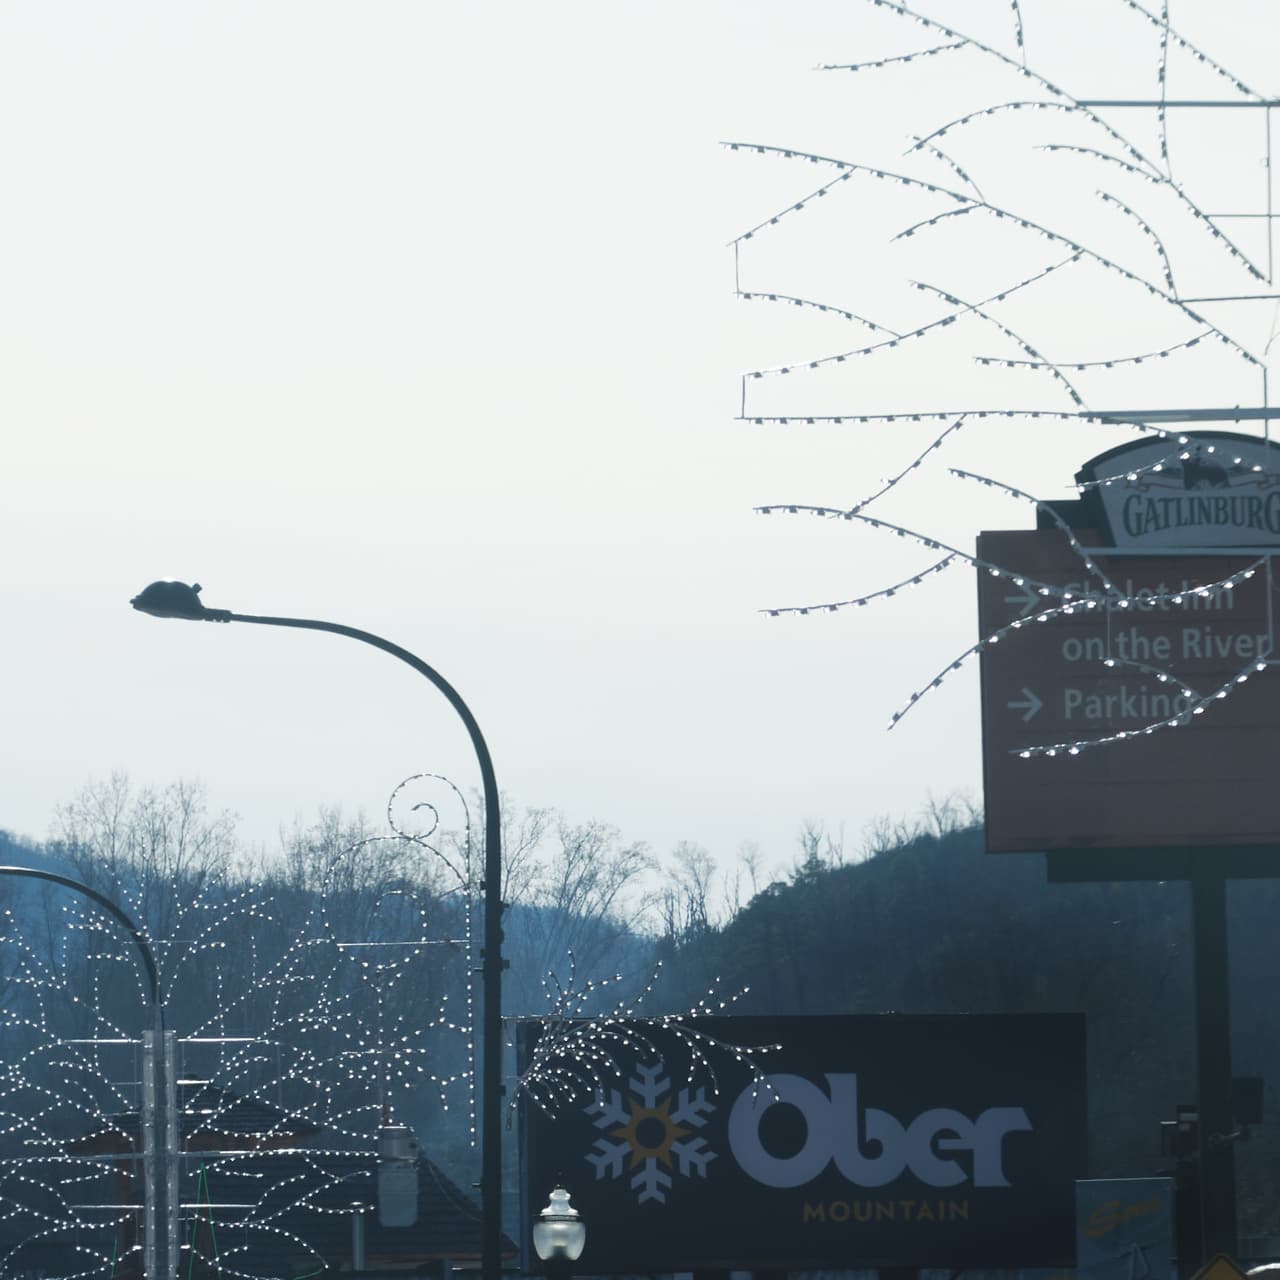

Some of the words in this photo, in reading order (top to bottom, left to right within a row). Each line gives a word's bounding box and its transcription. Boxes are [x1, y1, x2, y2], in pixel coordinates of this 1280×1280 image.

[1062, 637, 1104, 661] on
[1114, 627, 1170, 660] the
[1182, 626, 1268, 659] River
[1064, 685, 1193, 725] Parking
[728, 1073, 1033, 1188] Ober
[802, 1200, 969, 1223] MOUNTAIN
